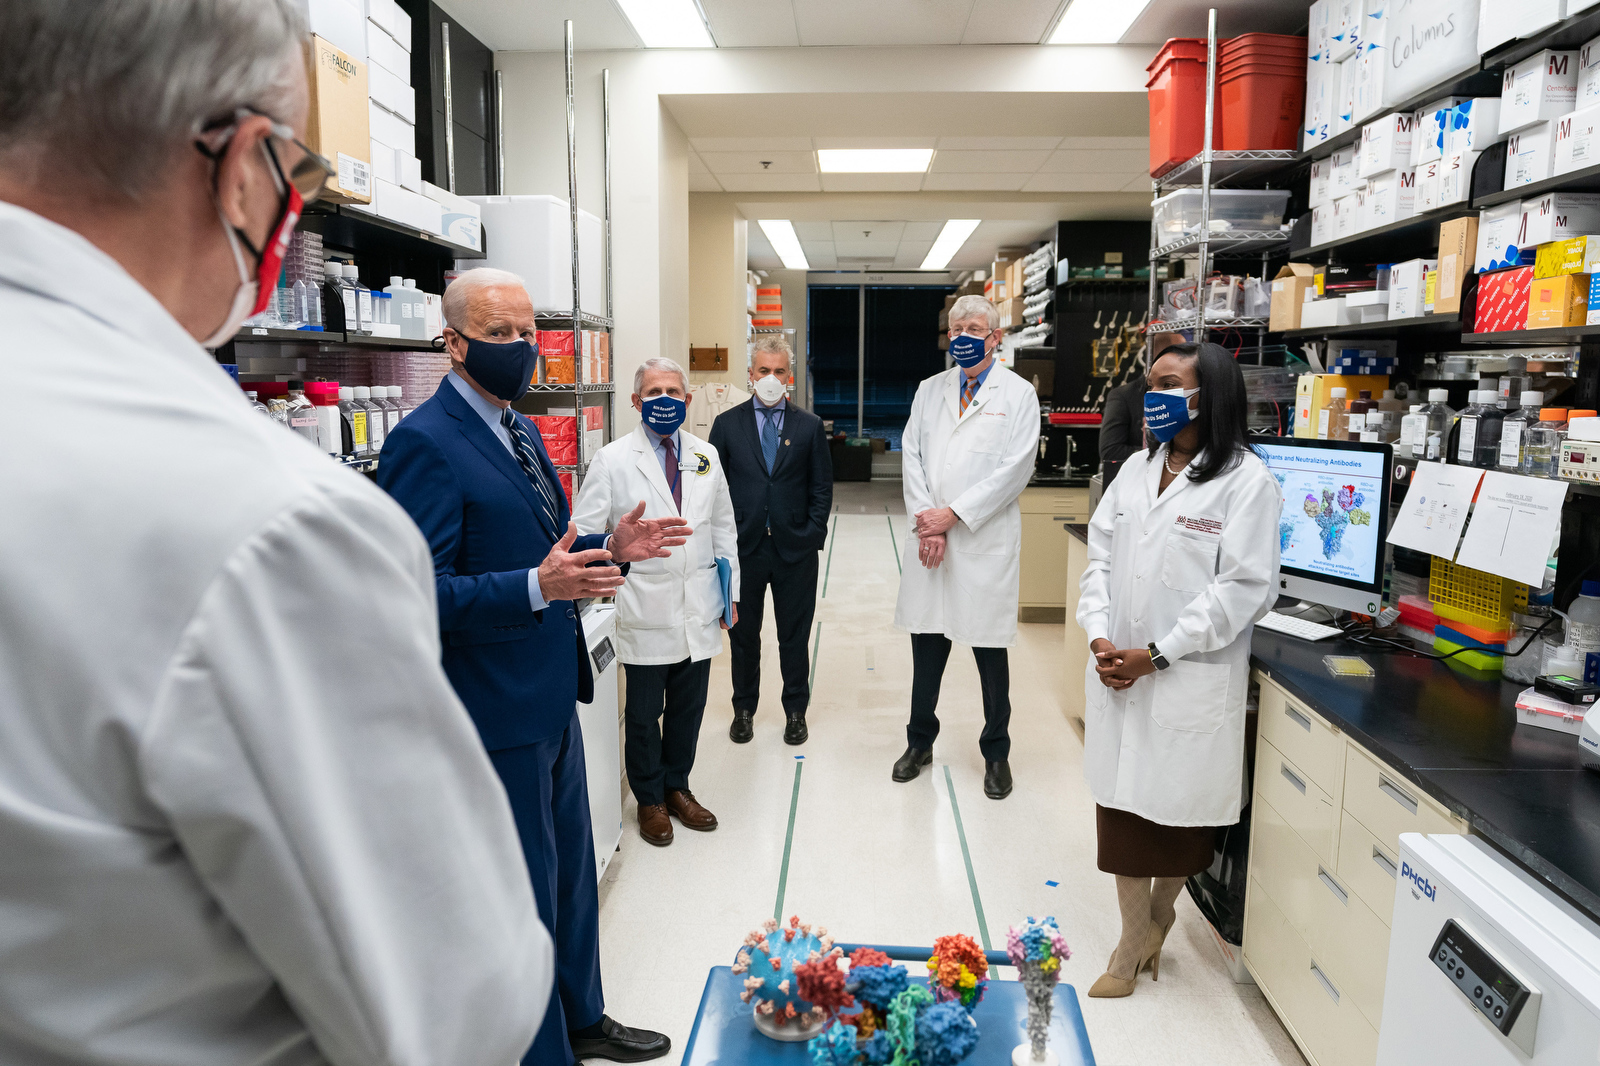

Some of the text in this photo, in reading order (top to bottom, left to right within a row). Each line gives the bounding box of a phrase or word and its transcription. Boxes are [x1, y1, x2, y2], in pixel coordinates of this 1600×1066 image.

[1392, 12, 1454, 68] Columns
[332, 54, 357, 76] FALCON
[1548, 55, 1568, 75] M
[1397, 117, 1412, 132] M
[1560, 118, 1571, 140] M
[1401, 172, 1415, 188] M
[1556, 216, 1567, 227] M
[1562, 259, 1582, 269] protein
[1485, 275, 1495, 290] QIAGEN
[1490, 286, 1500, 302] QIAGEN
[1509, 288, 1519, 304] QIAGEN
[1478, 296, 1488, 311] QIAGEN
[1496, 297, 1506, 313] QIAGEN
[1515, 300, 1527, 316] QIAGEN
[1484, 307, 1494, 322] QIAGEN
[1502, 309, 1513, 325] QIAGEN
[1156, 412, 1170, 420] Safe!
[1296, 456, 1328, 465] Neutralizing
[1330, 460, 1362, 468] Antibodies
[1313, 560, 1335, 568] Neutralizing
